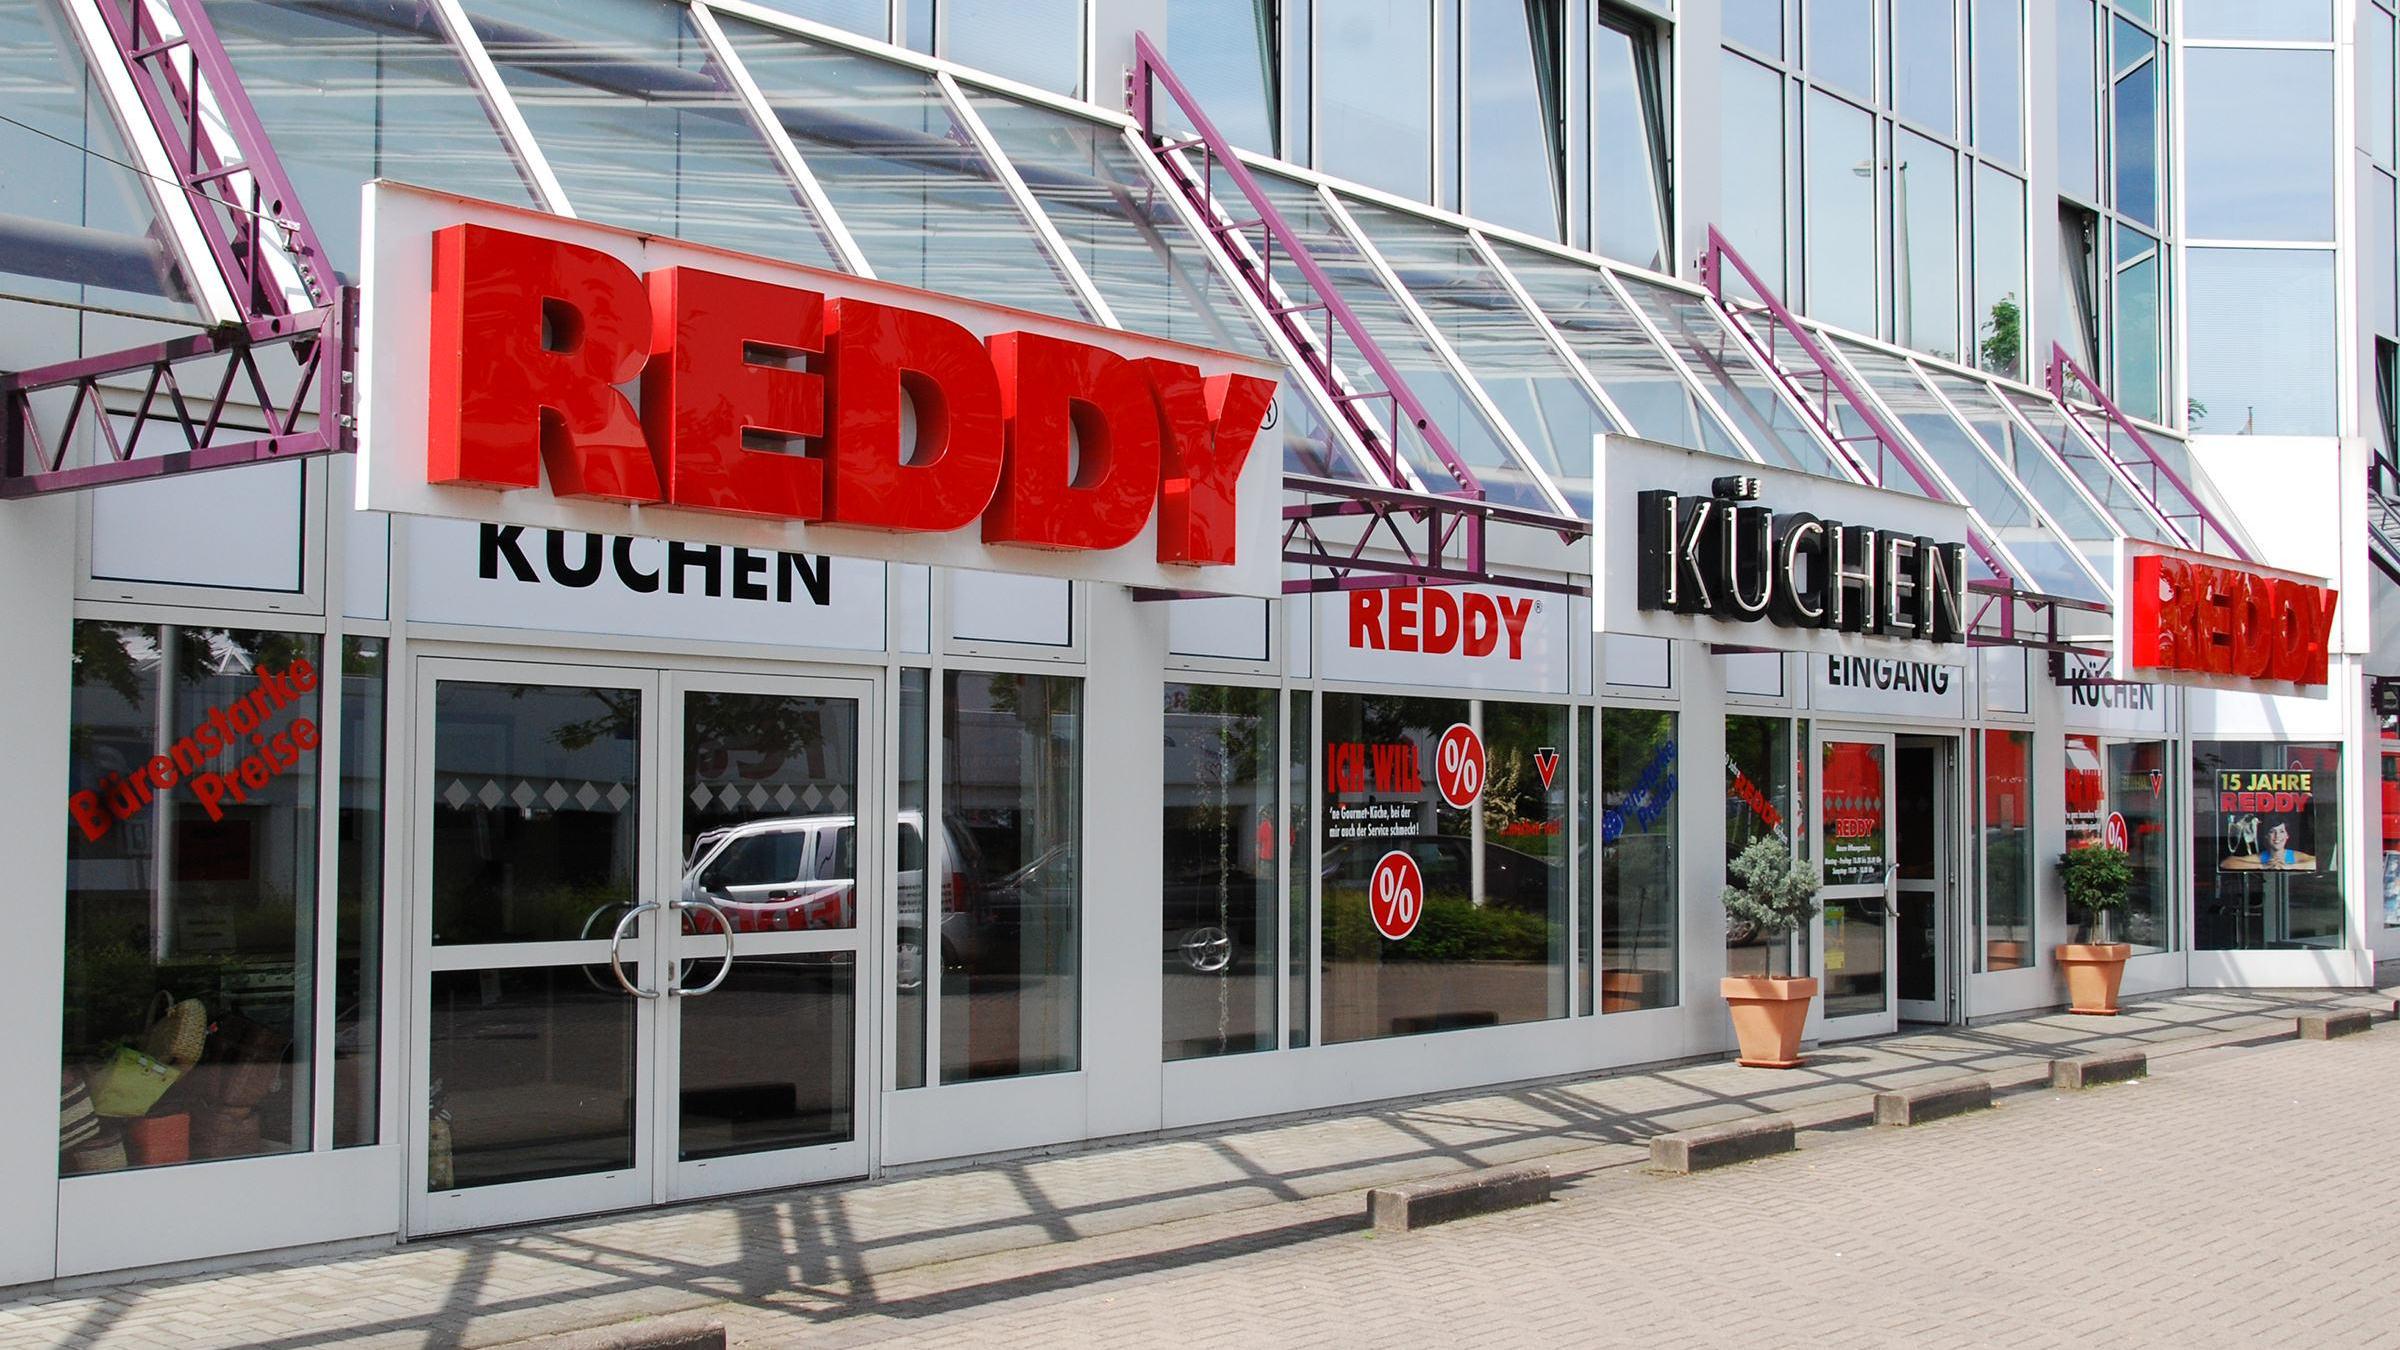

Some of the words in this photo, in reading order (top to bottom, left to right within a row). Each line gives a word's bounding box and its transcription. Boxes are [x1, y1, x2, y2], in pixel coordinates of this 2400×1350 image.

[427, 223, 1277, 566] REDDY
[1637, 475, 1966, 643] KÜCHEN
[1349, 586, 1534, 661] REDDY
[2133, 554, 2339, 686] REDDY
[1828, 654, 1949, 695] EINGANG
[2071, 661, 2153, 711] KÜCHEN
[189, 717, 320, 823] Preise
[1327, 743, 1365, 794] ICH
[1371, 743, 1423, 794] WILL
[2221, 773, 2242, 791] 15
[2246, 773, 2312, 791] JAHRE
[1390, 805, 1400, 818] bei
[1401, 805, 1411, 818] der
[2220, 792, 2311, 813] REDDY
[1356, 823, 1367, 837] der
[1368, 823, 1389, 837] Service
[1835, 818, 1873, 838] REDDY
